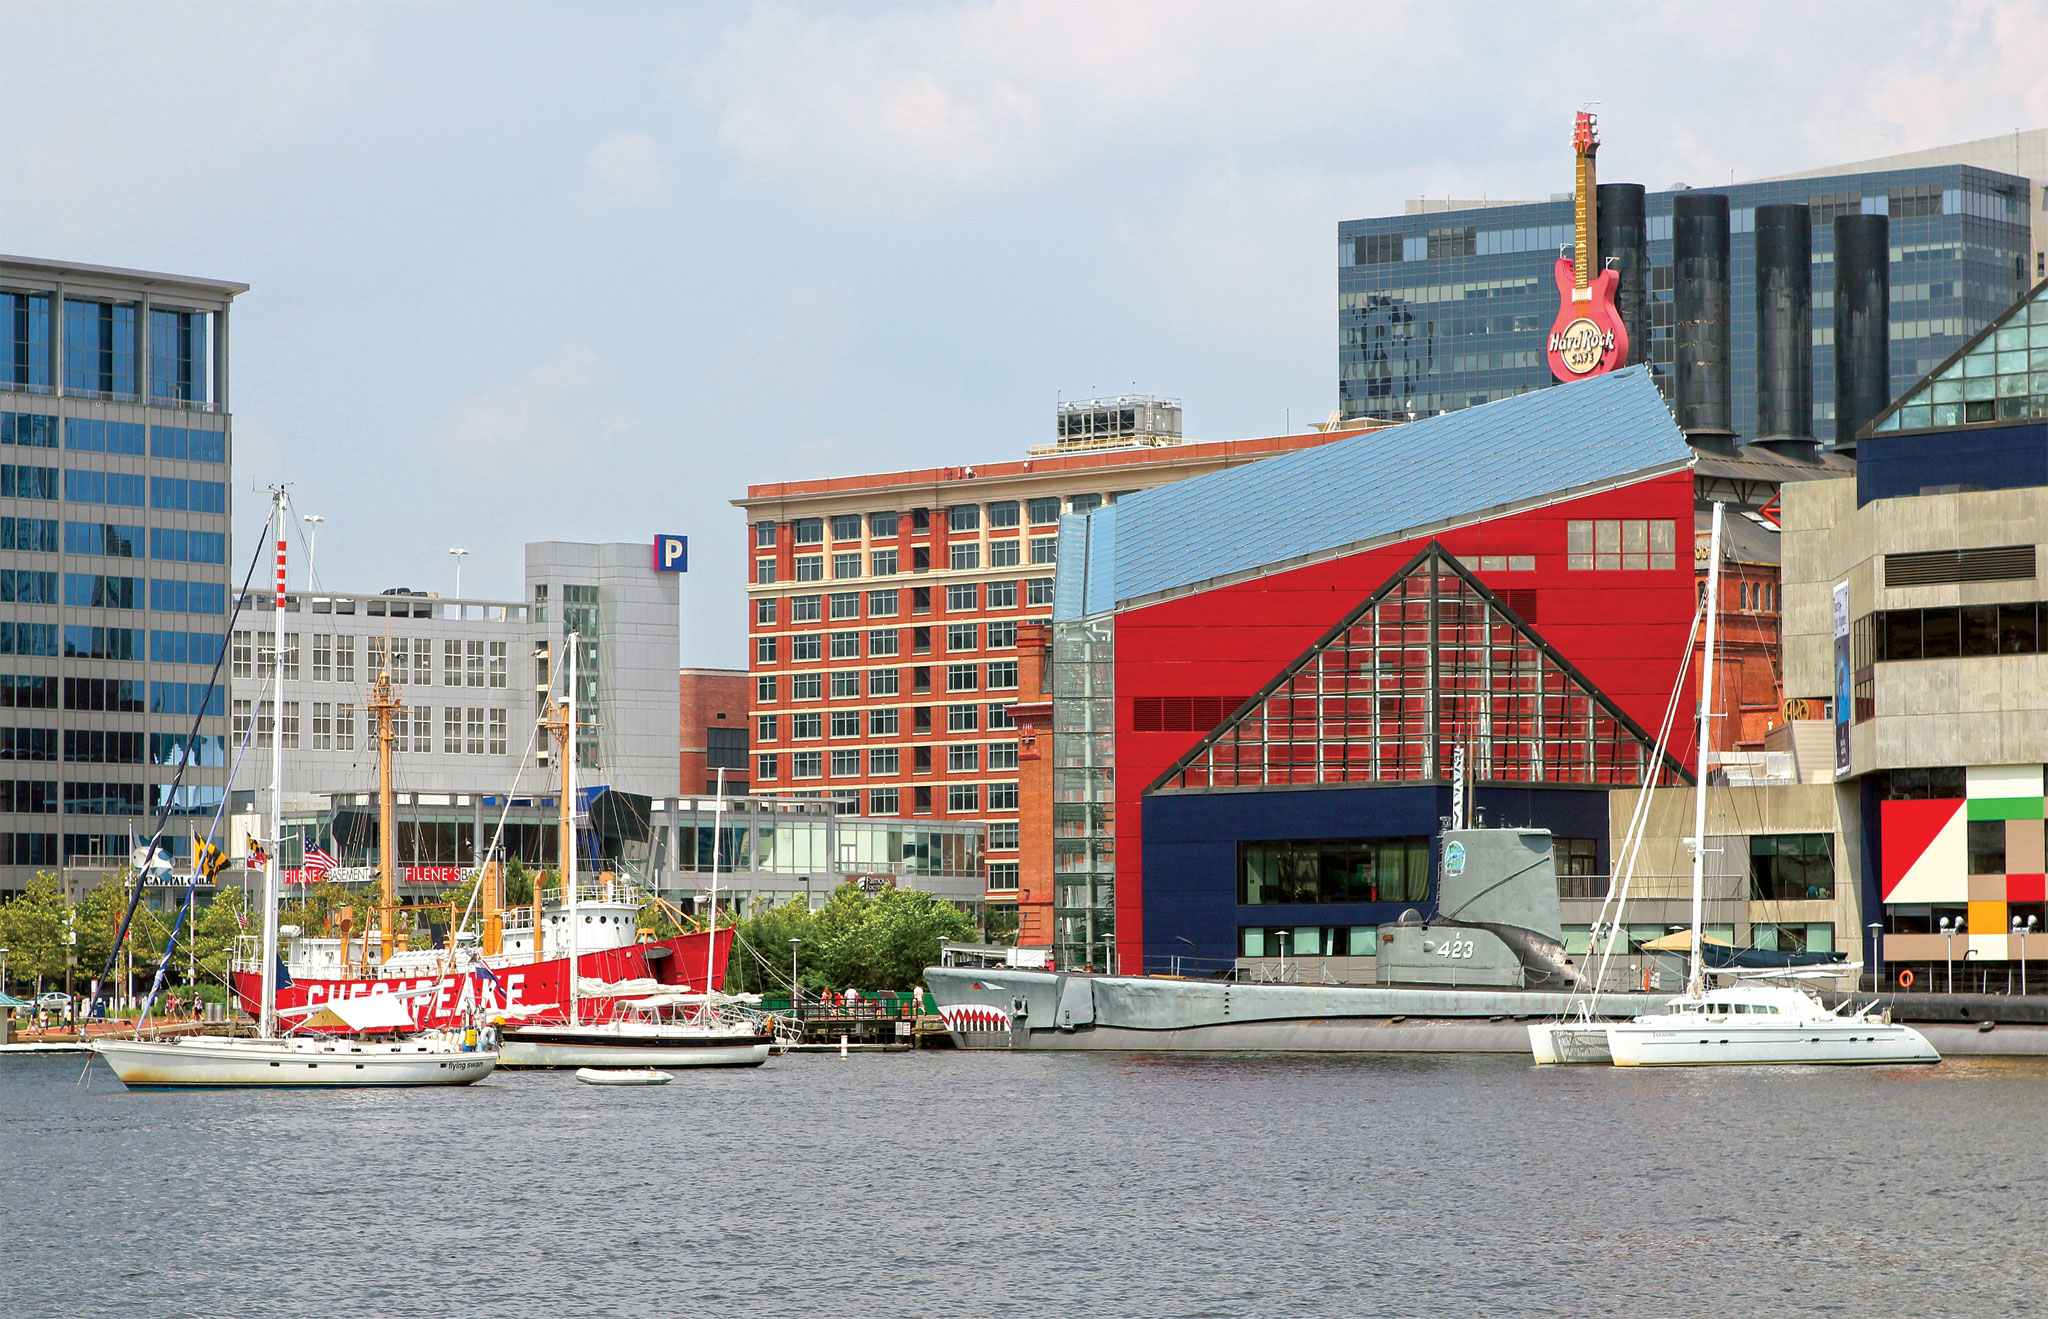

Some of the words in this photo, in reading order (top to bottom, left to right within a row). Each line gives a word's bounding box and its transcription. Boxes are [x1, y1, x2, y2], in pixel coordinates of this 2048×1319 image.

[1549, 331, 1583, 351] Hard
[1583, 328, 1615, 351] Rock
[1571, 352, 1594, 364] CAFE
[665, 538, 683, 567] P
[145, 876, 187, 886] CATAL
[285, 869, 321, 883] FILENE
[327, 868, 370, 881] BASEMENT
[405, 868, 460, 881] FILENE'S
[1437, 940, 1474, 959] 423
[448, 1062, 466, 1071] flying
